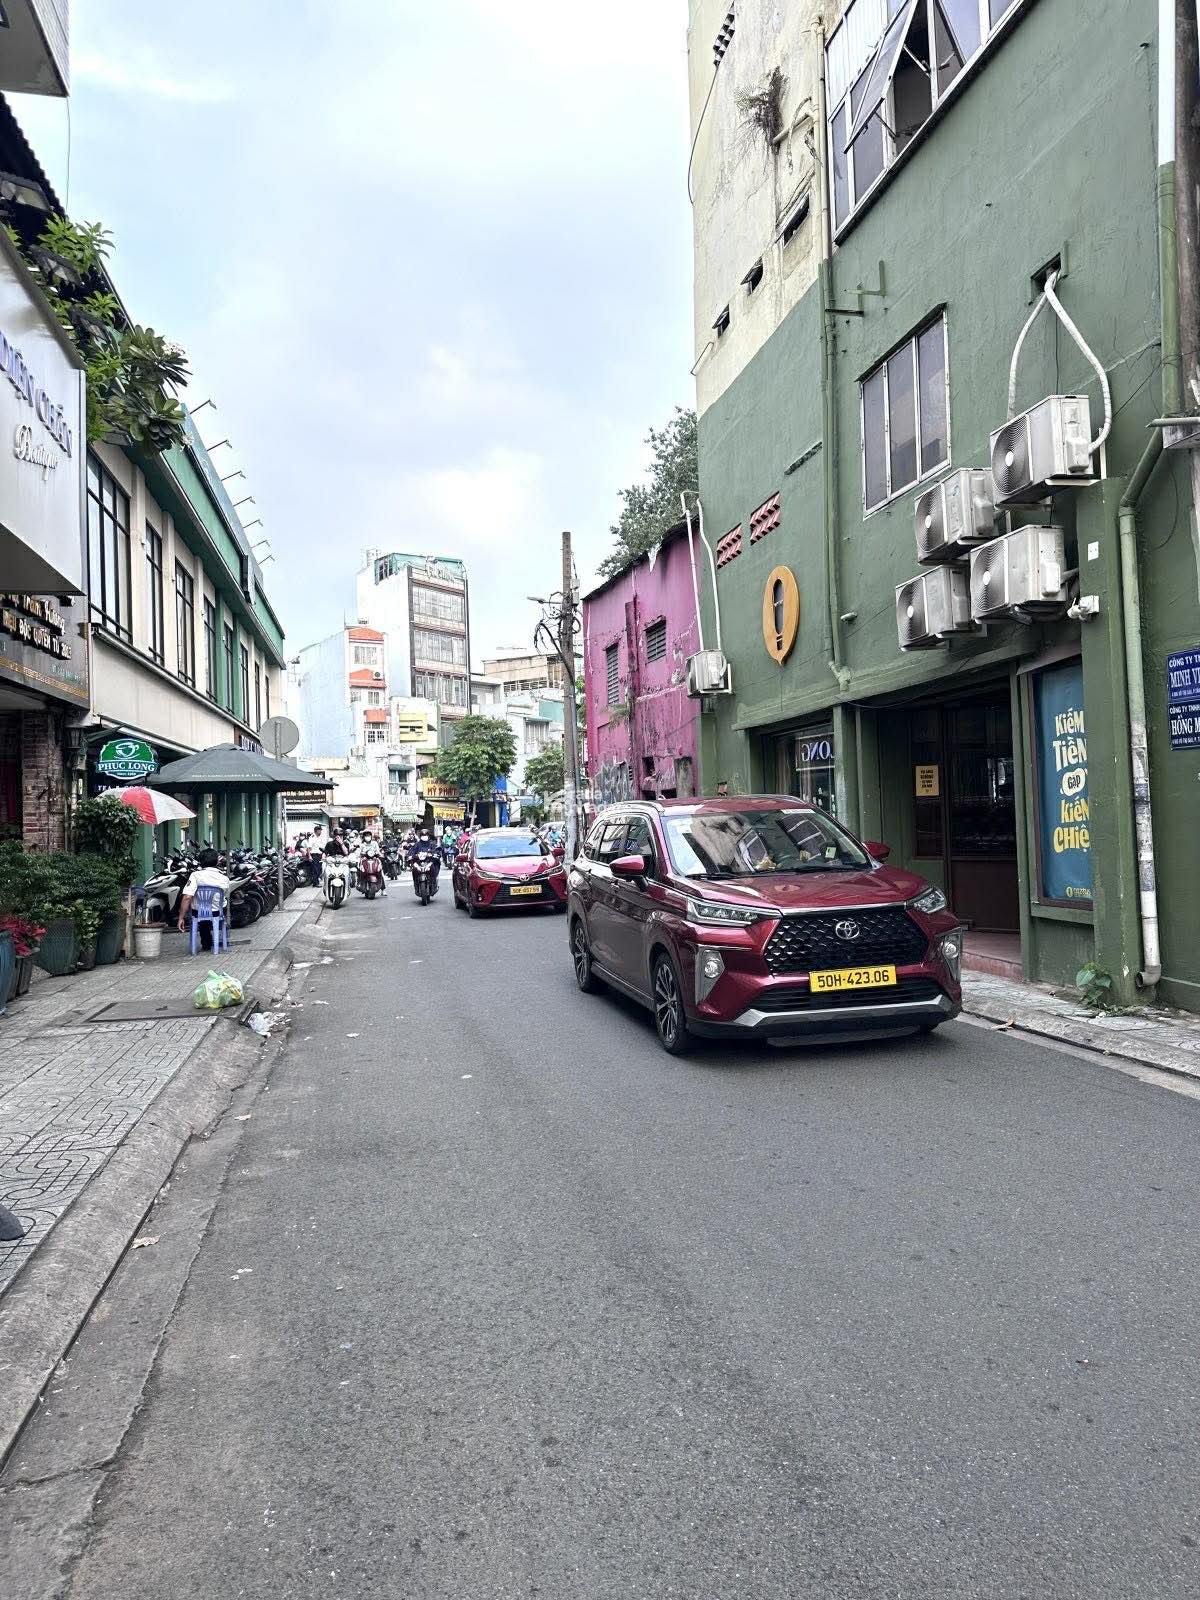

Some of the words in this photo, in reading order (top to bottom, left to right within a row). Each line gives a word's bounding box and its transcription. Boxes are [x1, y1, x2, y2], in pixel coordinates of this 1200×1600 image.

[1169, 657, 1184, 668] CÔNG
[1186, 656, 1193, 664] TY
[1170, 669, 1191, 688] MINH
[1171, 714, 1193, 735] HỒNG
[98, 762, 126, 771] PHUC
[128, 762, 155, 772] LONG
[817, 970, 890, 988] 50H-423.06
